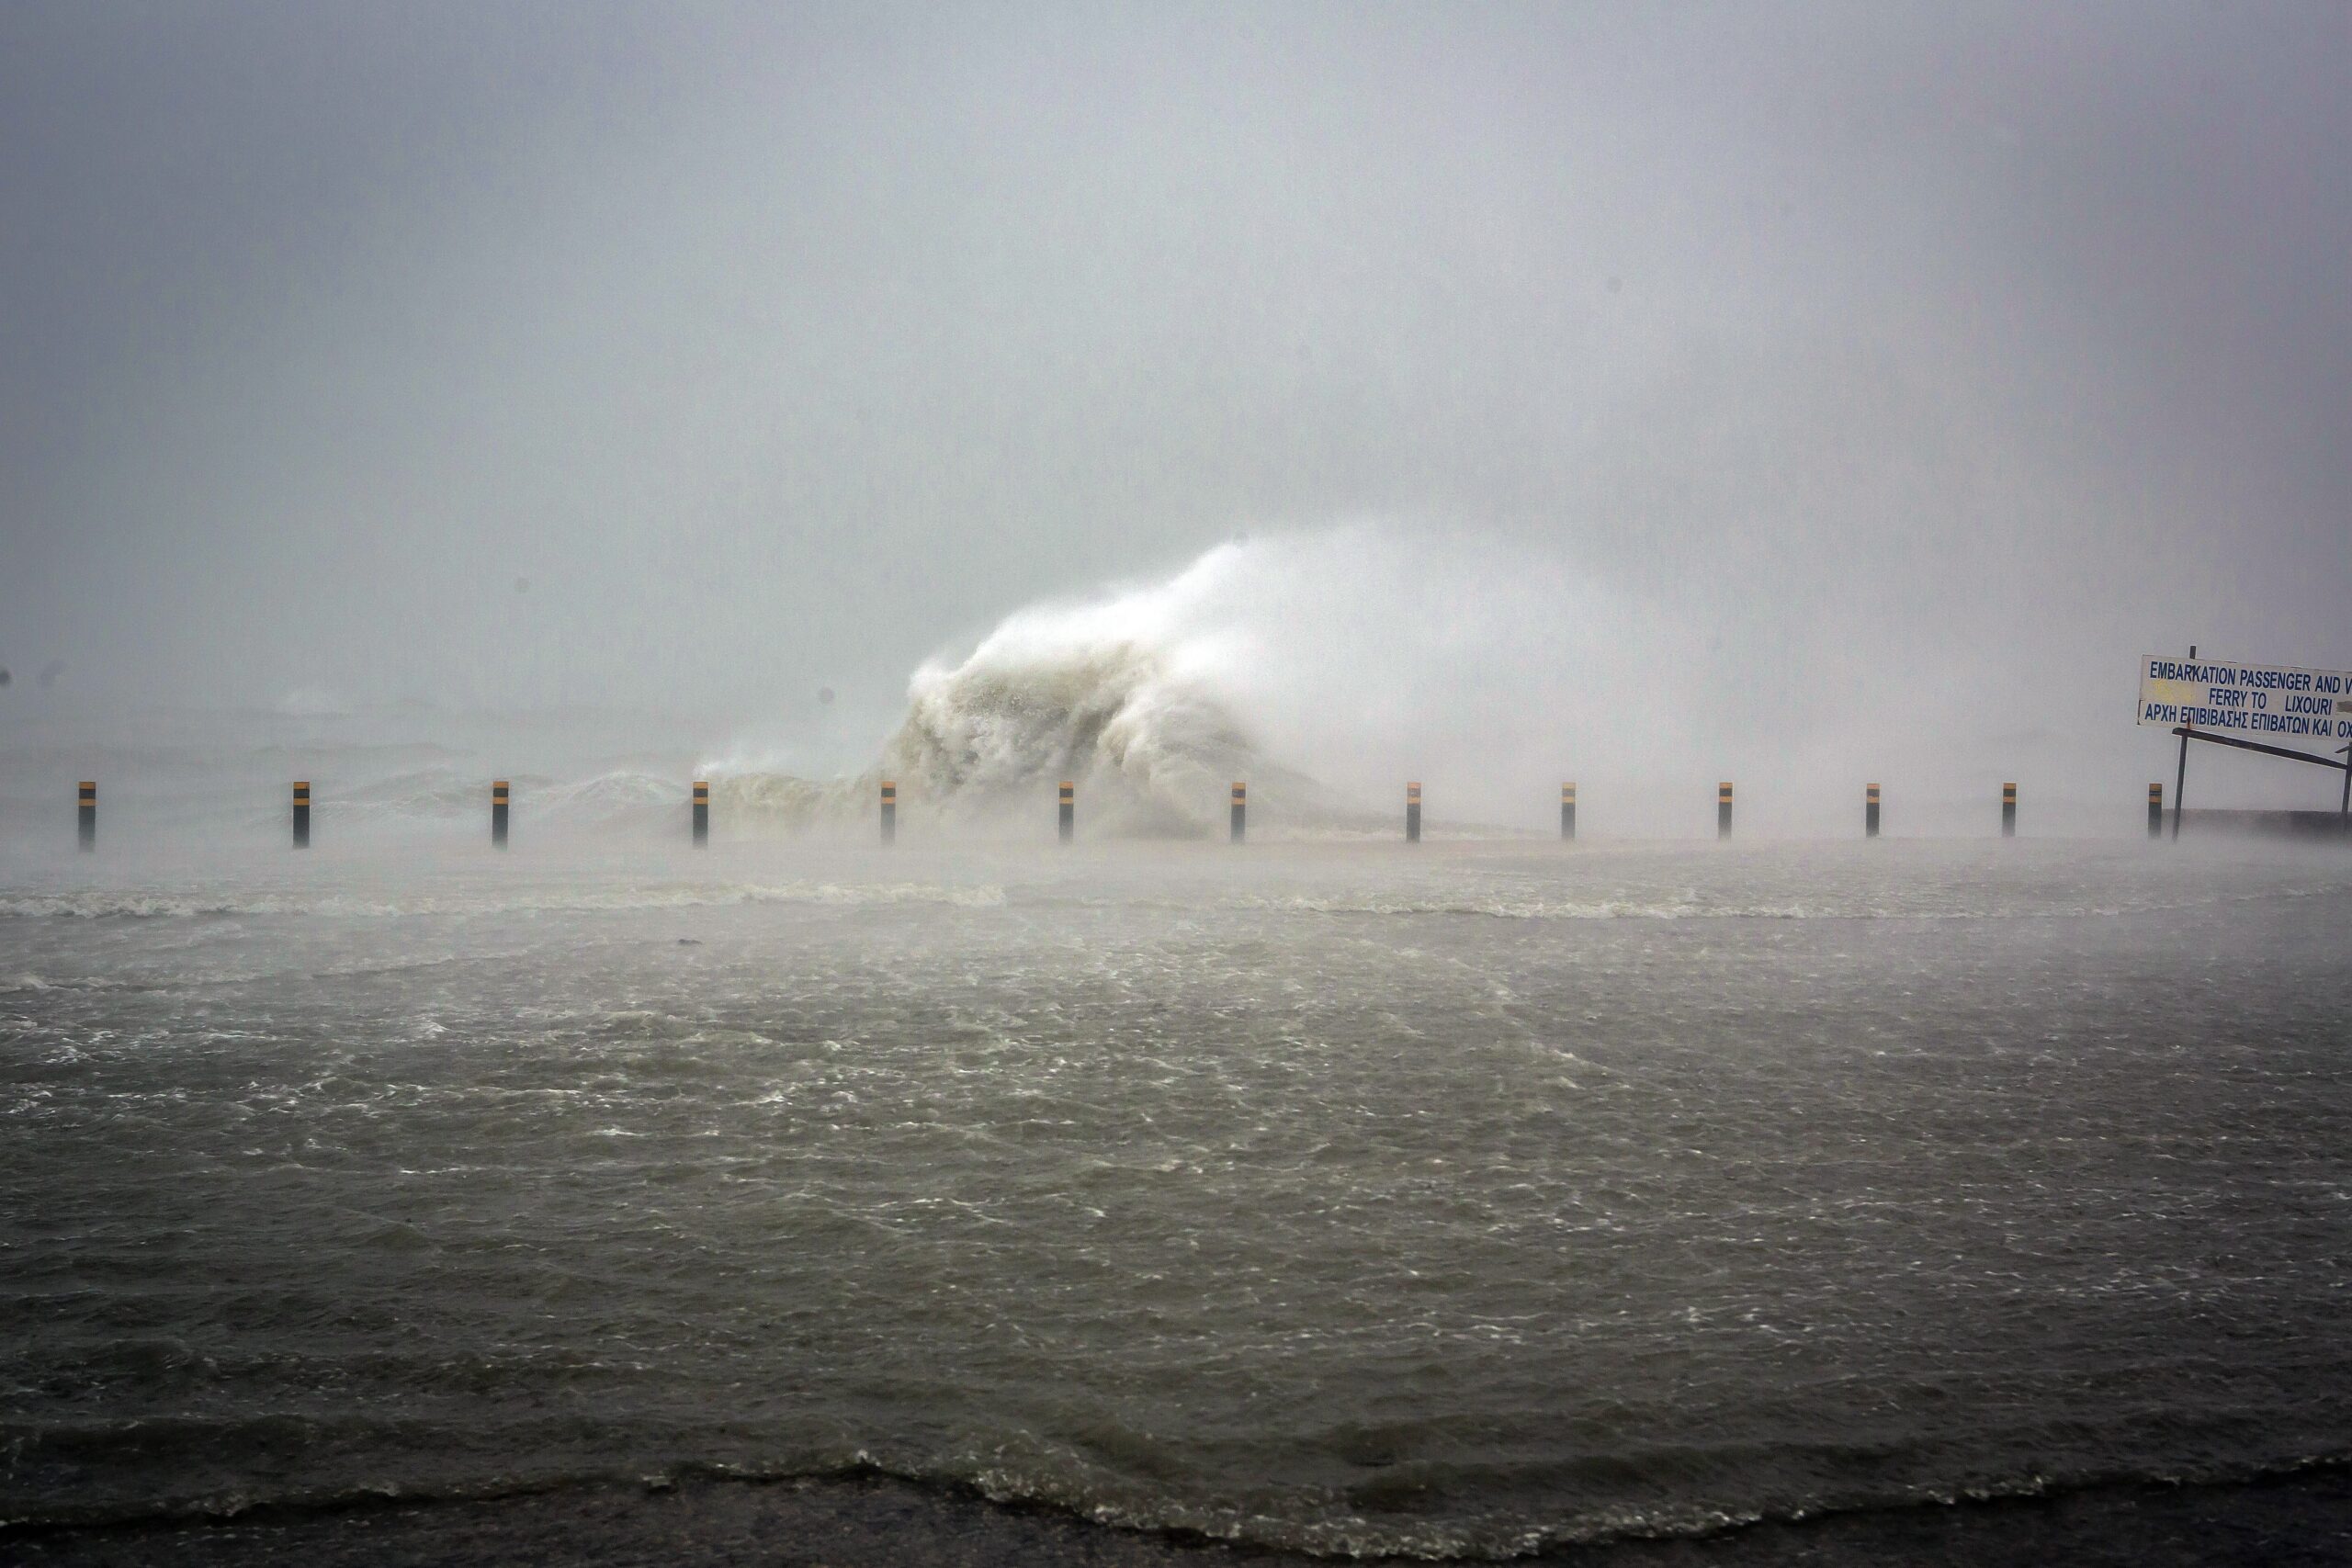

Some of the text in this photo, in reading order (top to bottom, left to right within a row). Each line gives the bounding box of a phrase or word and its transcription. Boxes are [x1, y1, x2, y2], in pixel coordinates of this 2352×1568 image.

[2150, 661, 2236, 685] EMBARKATION
[2239, 669, 2310, 691] PASSENGER
[2315, 676, 2341, 693] AND
[2209, 688, 2332, 715] FERRY TO LIXOURI
[2145, 704, 2176, 722] ΑΡΧΗ
[2180, 706, 2248, 729] ΕΠΙΒΙΒΑΣΗΣ
[2252, 713, 2309, 734] ΕΠΙΒΑΤΩΝ
[2312, 719, 2332, 736] ΚΑΙ
